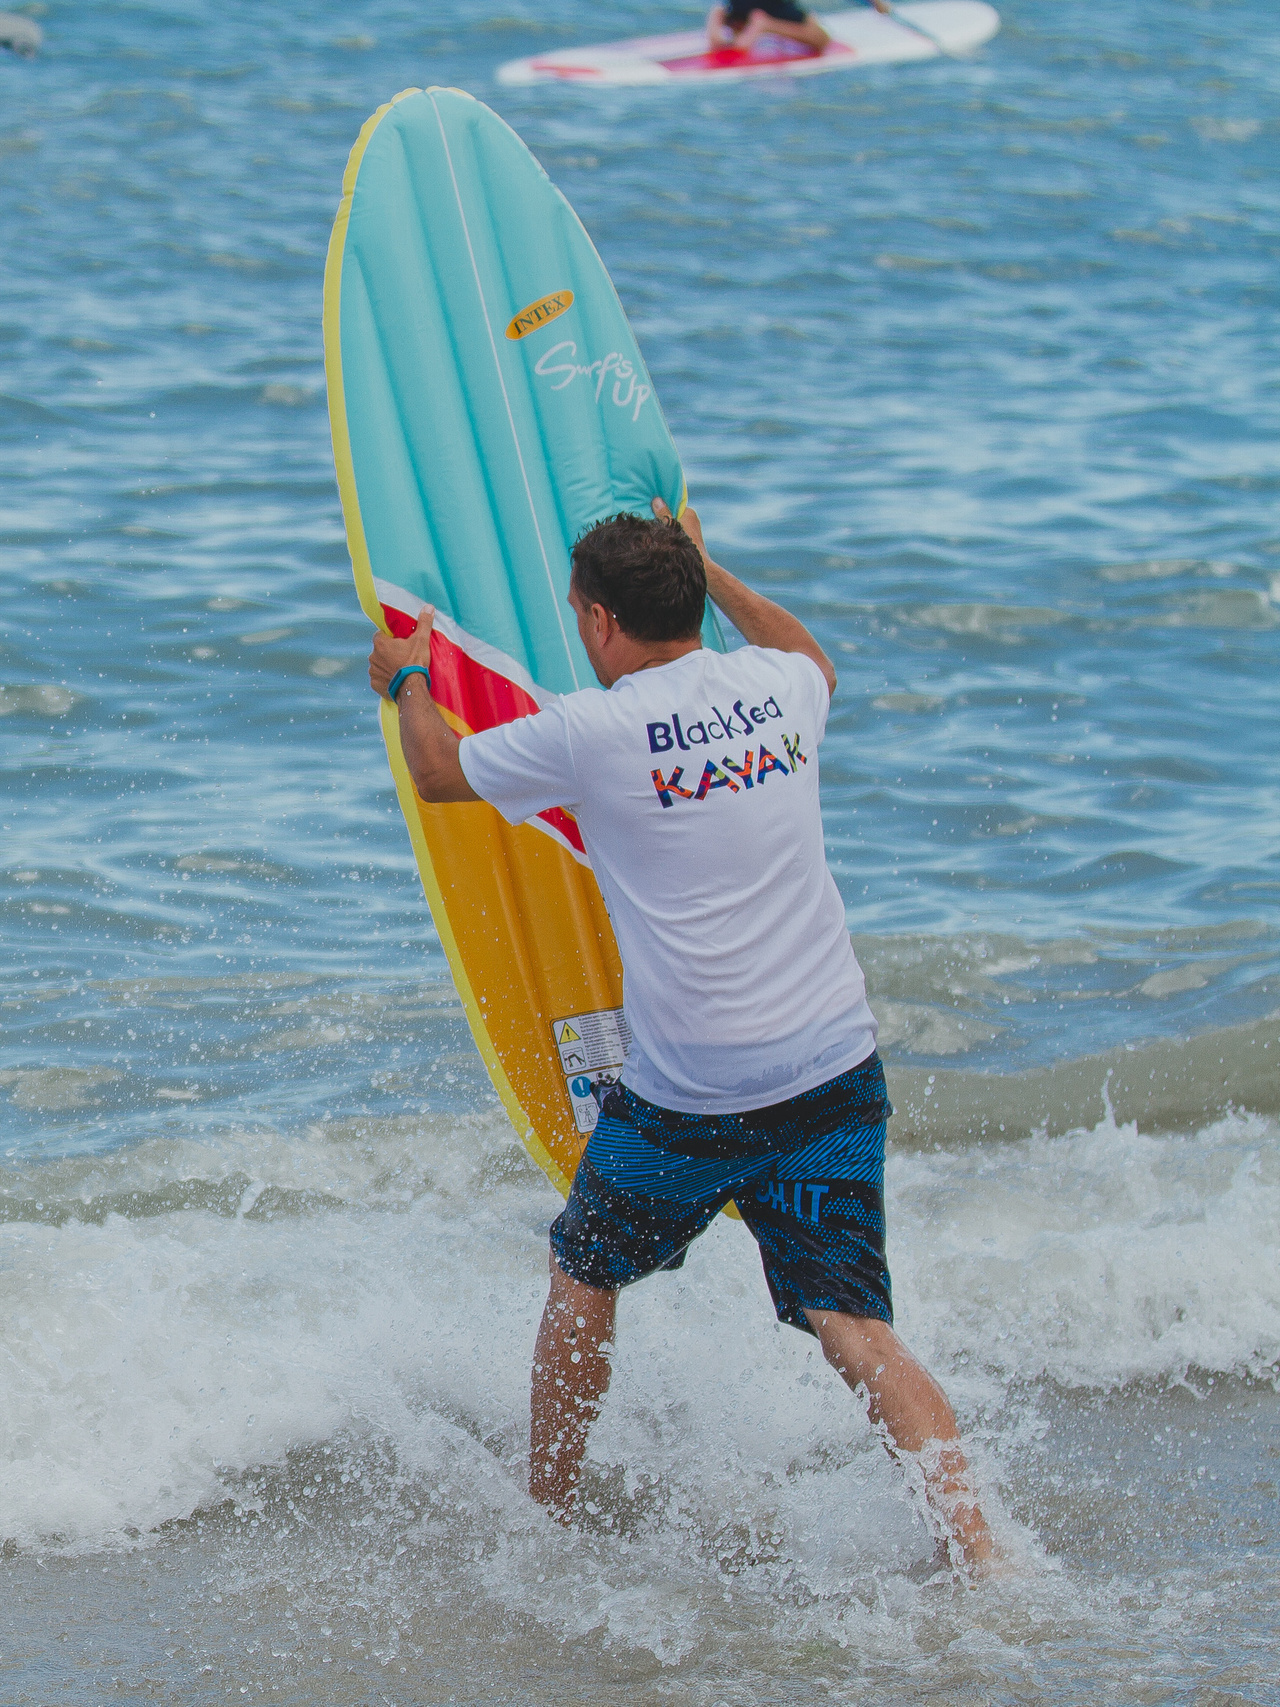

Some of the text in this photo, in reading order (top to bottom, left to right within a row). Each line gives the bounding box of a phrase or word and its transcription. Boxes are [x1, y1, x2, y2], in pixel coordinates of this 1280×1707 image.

[513, 294, 566, 336] INTEX
[534, 340, 633, 405] Surf's
[612, 374, 651, 422] Up
[650, 732, 808, 809] KAYAK
